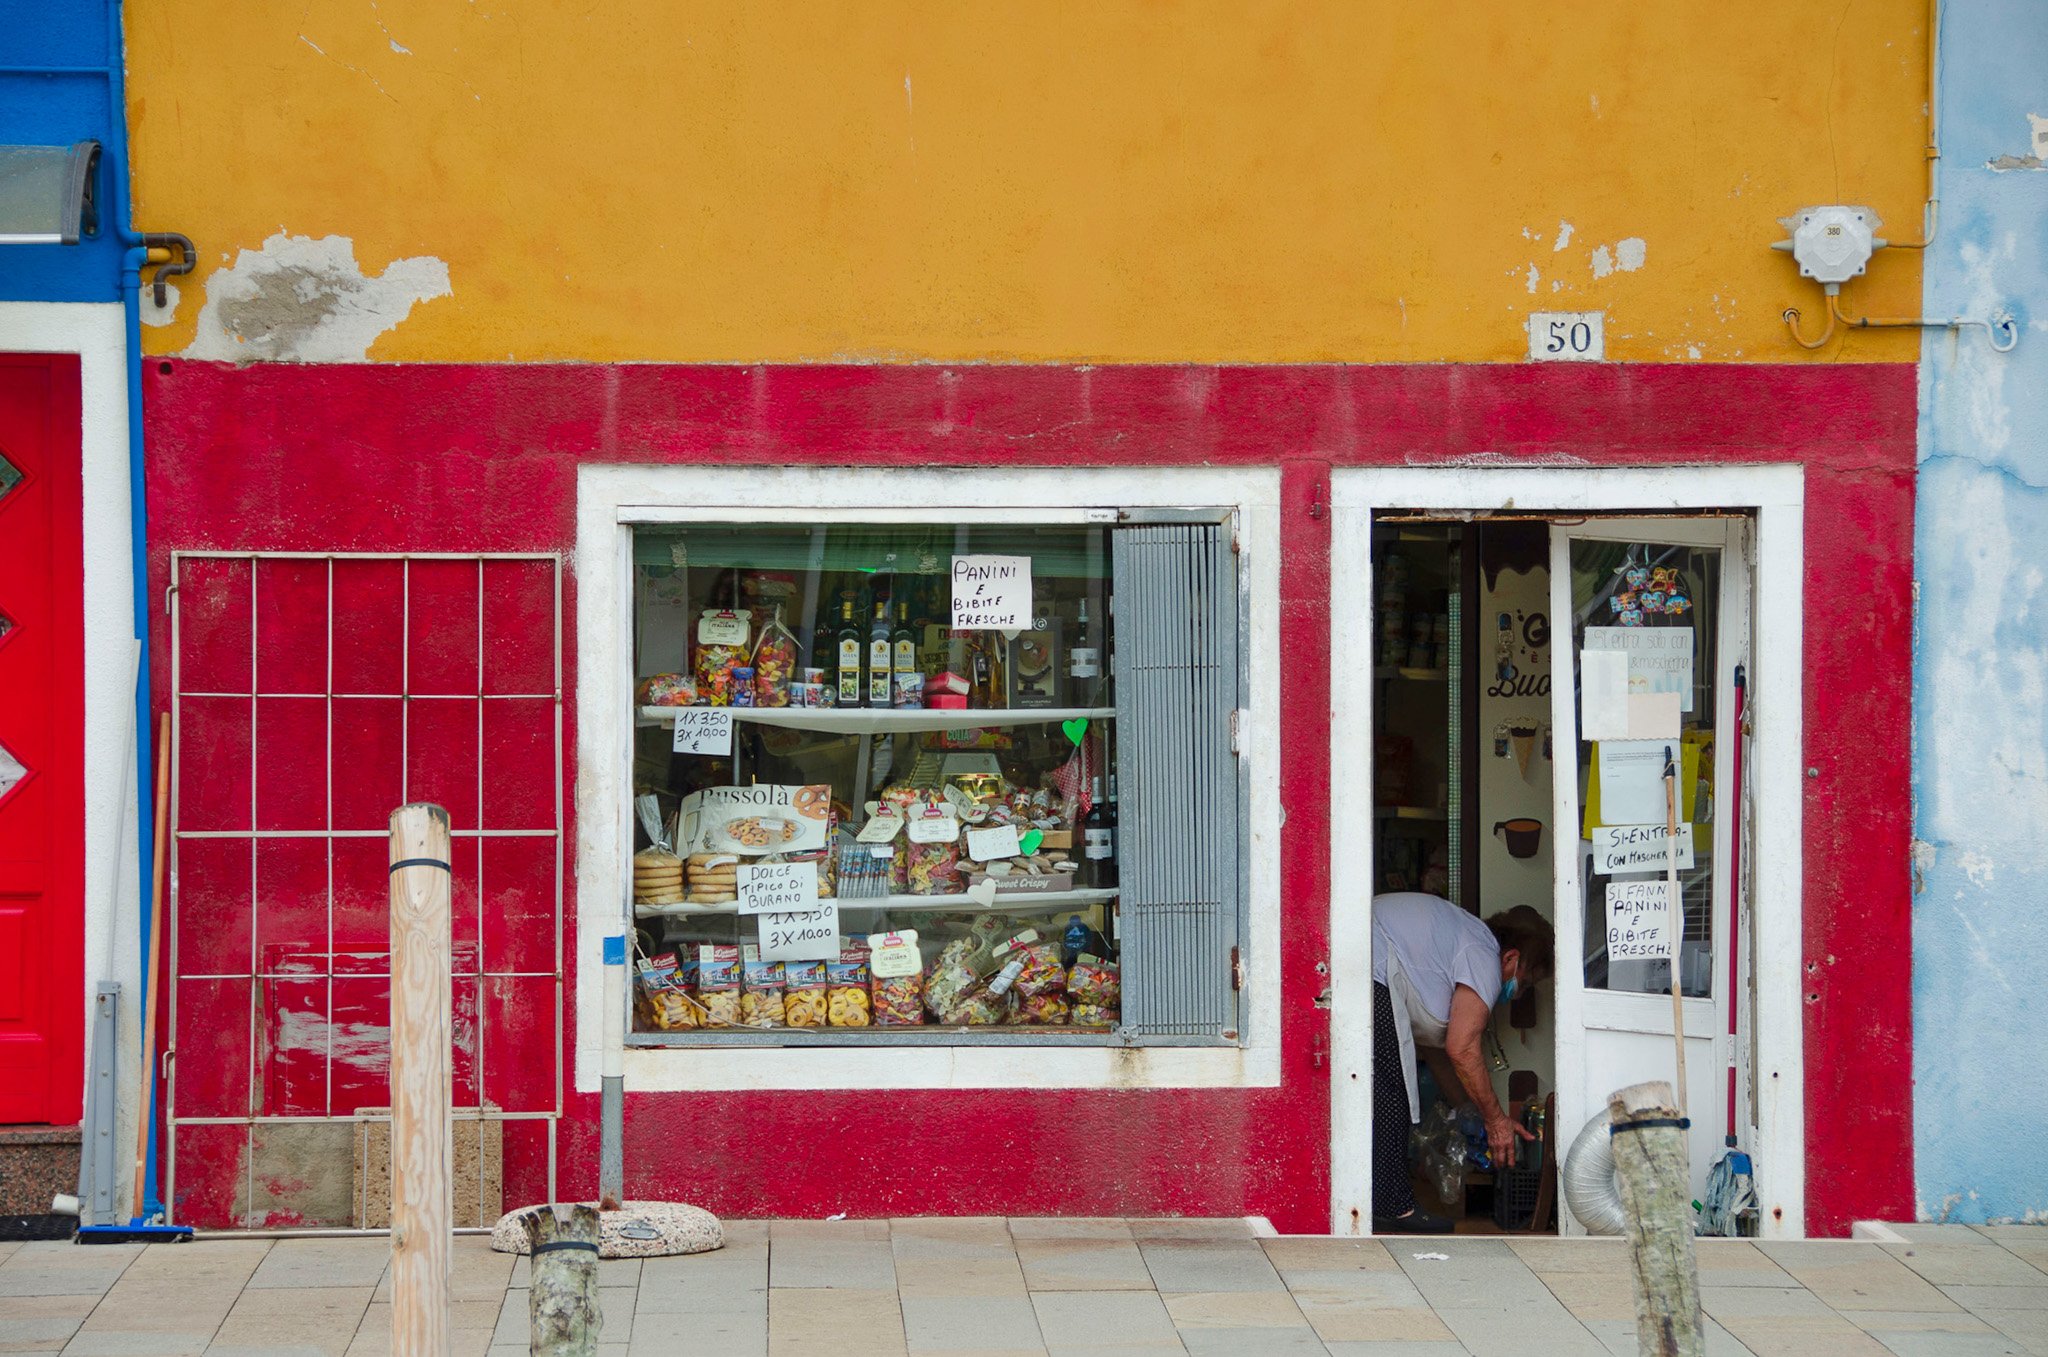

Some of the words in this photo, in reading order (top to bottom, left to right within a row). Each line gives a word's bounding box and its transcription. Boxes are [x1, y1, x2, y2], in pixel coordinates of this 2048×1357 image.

[1828, 227, 1840, 235] 380
[1547, 322, 1590, 352] 50
[954, 560, 1015, 582] PANINI
[976, 584, 984, 595] E
[954, 596, 1002, 610] BIBITE
[958, 614, 1014, 626] FRESCHE
[1611, 632, 1640, 649] entra
[1647, 631, 1667, 649] solo
[1671, 633, 1688, 649] con
[692, 741, 699, 751] €
[751, 865, 791, 880] DOLCE
[1019, 877, 1049, 889] Crispy
[749, 894, 800, 908] BURANO
[1613, 897, 1667, 916] PANINI
[1632, 915, 1640, 925] E
[1609, 928, 1659, 943] BIBITE
